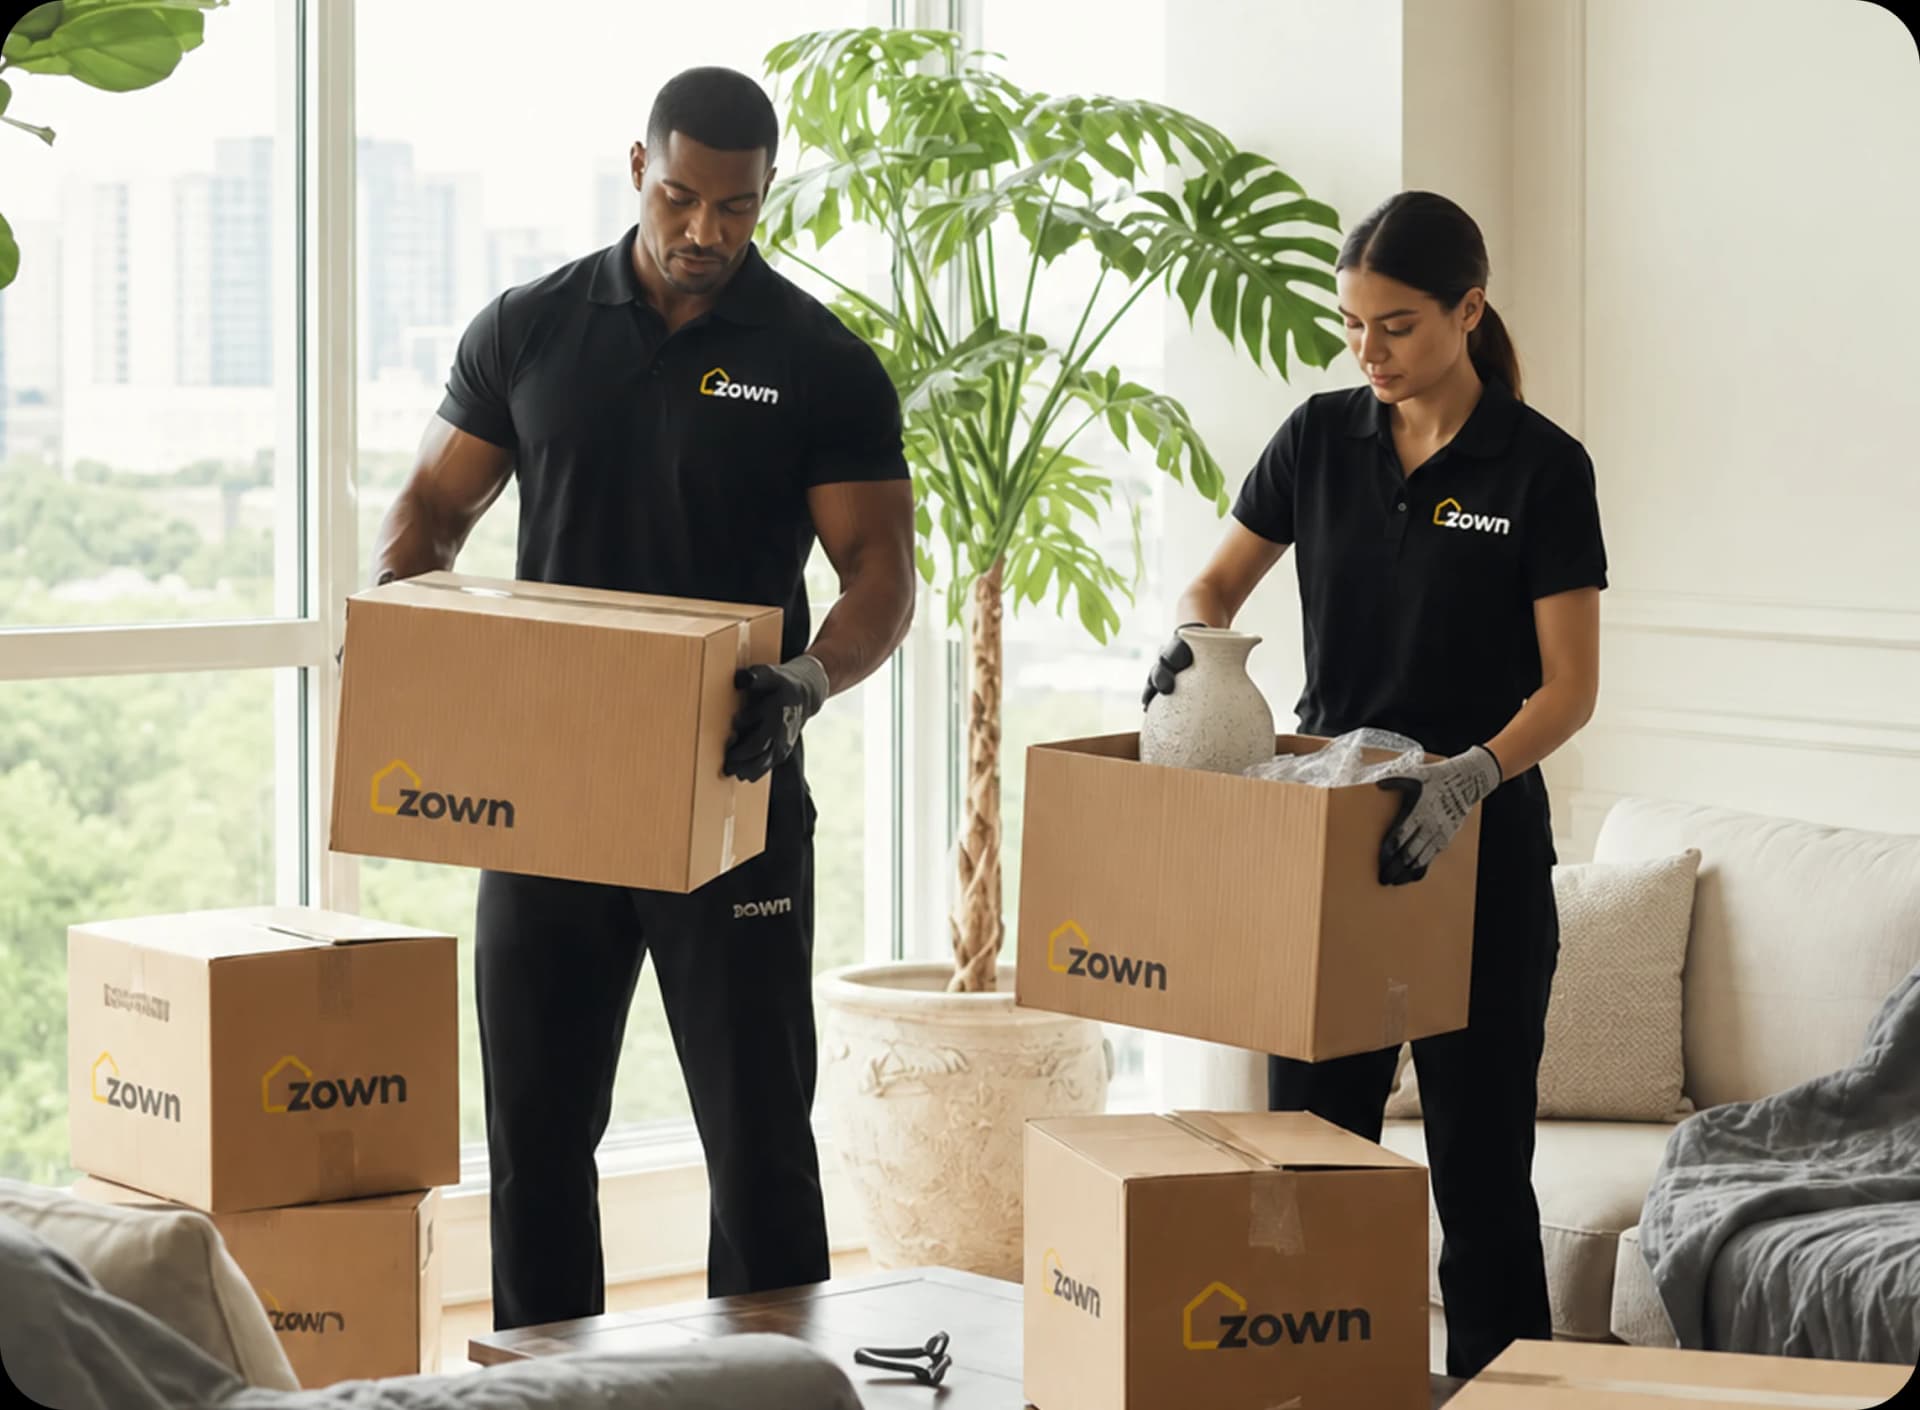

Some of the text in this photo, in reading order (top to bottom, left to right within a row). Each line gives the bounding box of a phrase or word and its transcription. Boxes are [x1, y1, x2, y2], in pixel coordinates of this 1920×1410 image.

[713, 380, 779, 404] zown
[1445, 511, 1510, 535] zown
[397, 787, 515, 828] zown
[1067, 946, 1167, 991] zown
[107, 1077, 181, 1123] zown
[287, 1074, 407, 1112] zown
[1053, 1268, 1100, 1319] zown
[1217, 1306, 1371, 1349] zown
